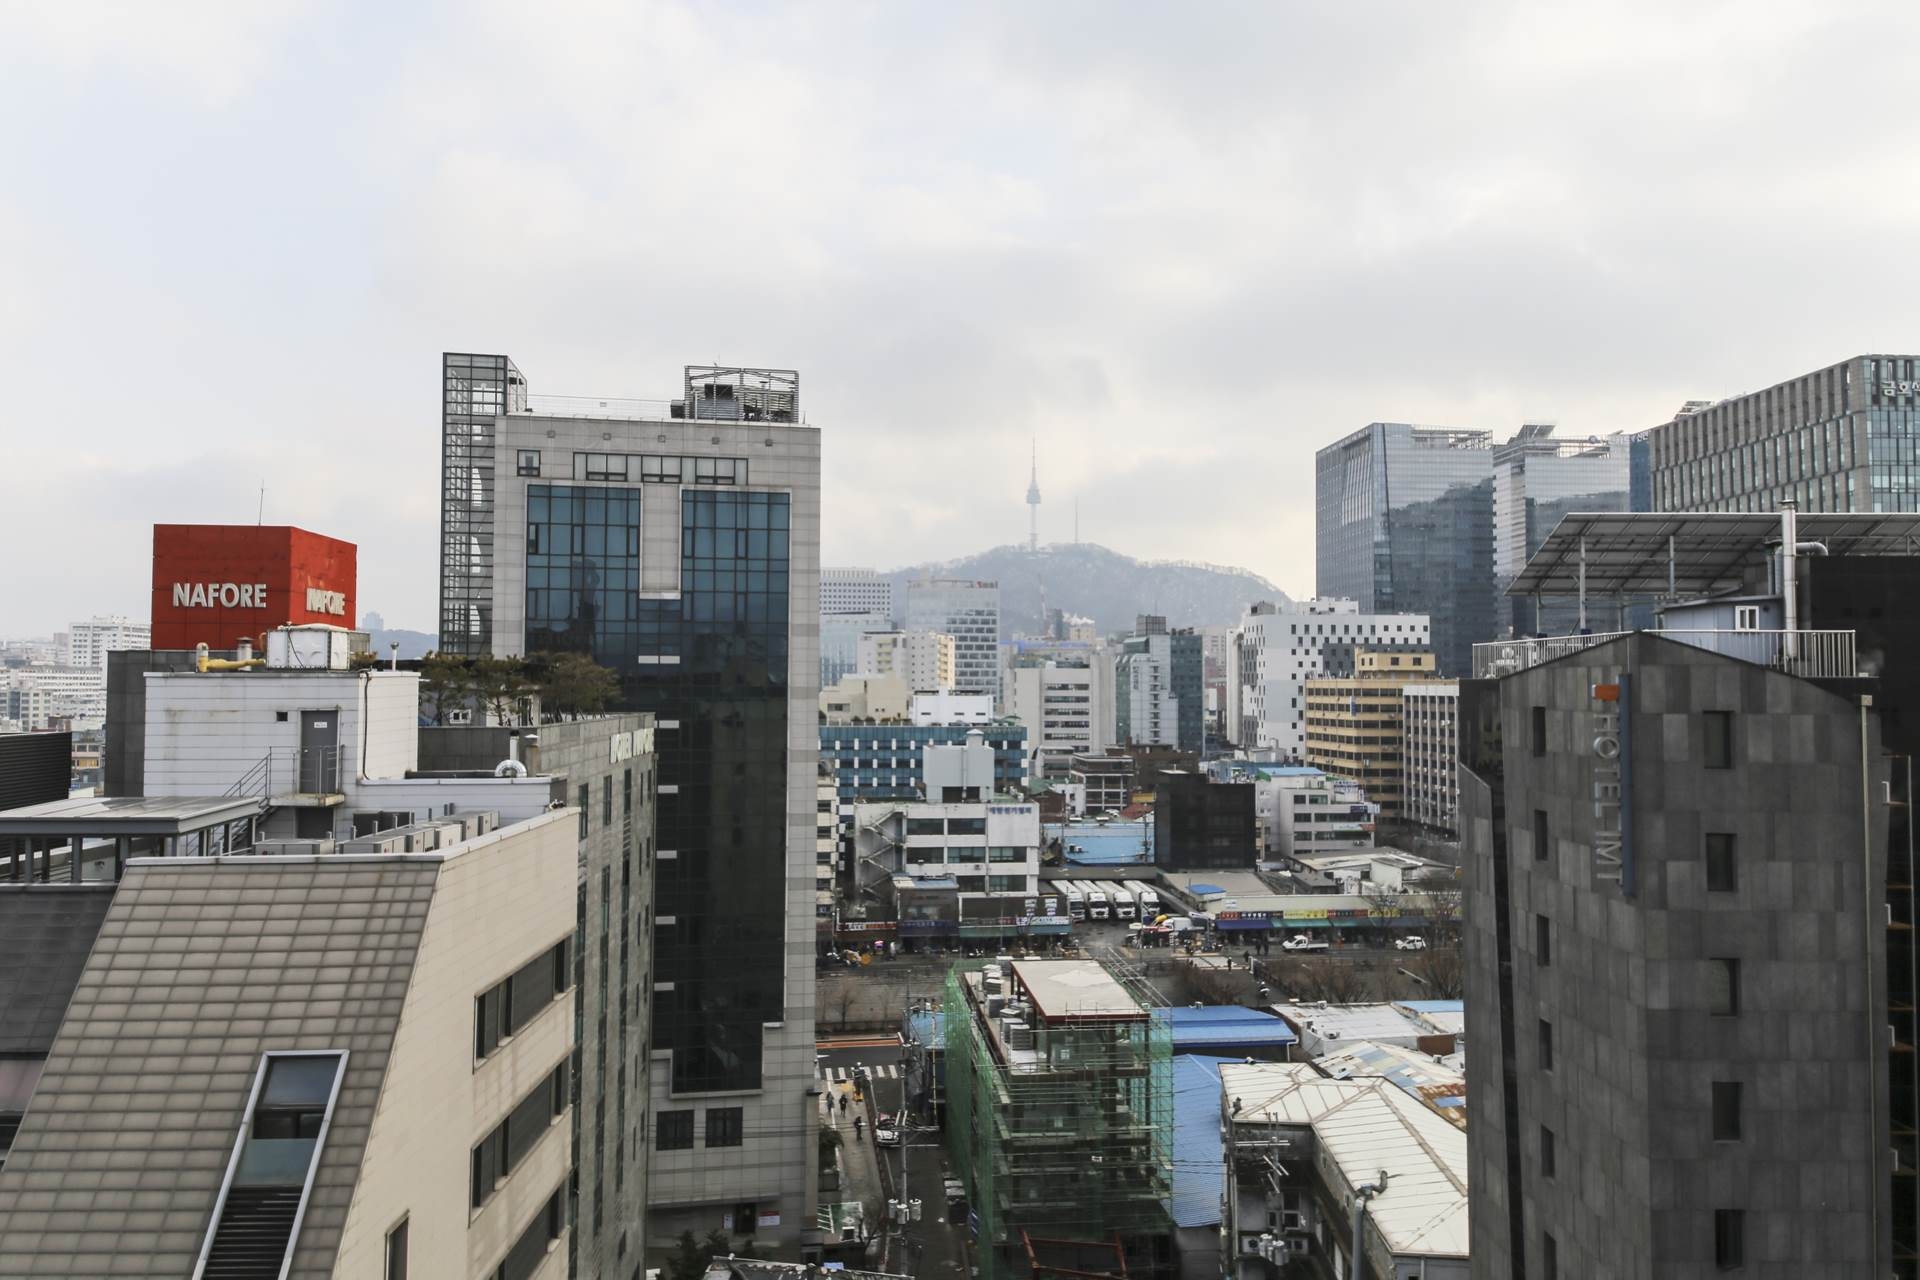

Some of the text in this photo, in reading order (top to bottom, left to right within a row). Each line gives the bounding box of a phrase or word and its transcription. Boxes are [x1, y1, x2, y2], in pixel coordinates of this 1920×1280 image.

[172, 583, 267, 608] NAFORE
[307, 588, 345, 615] NAFORE
[1593, 713, 1622, 885] HOTEL IMT
